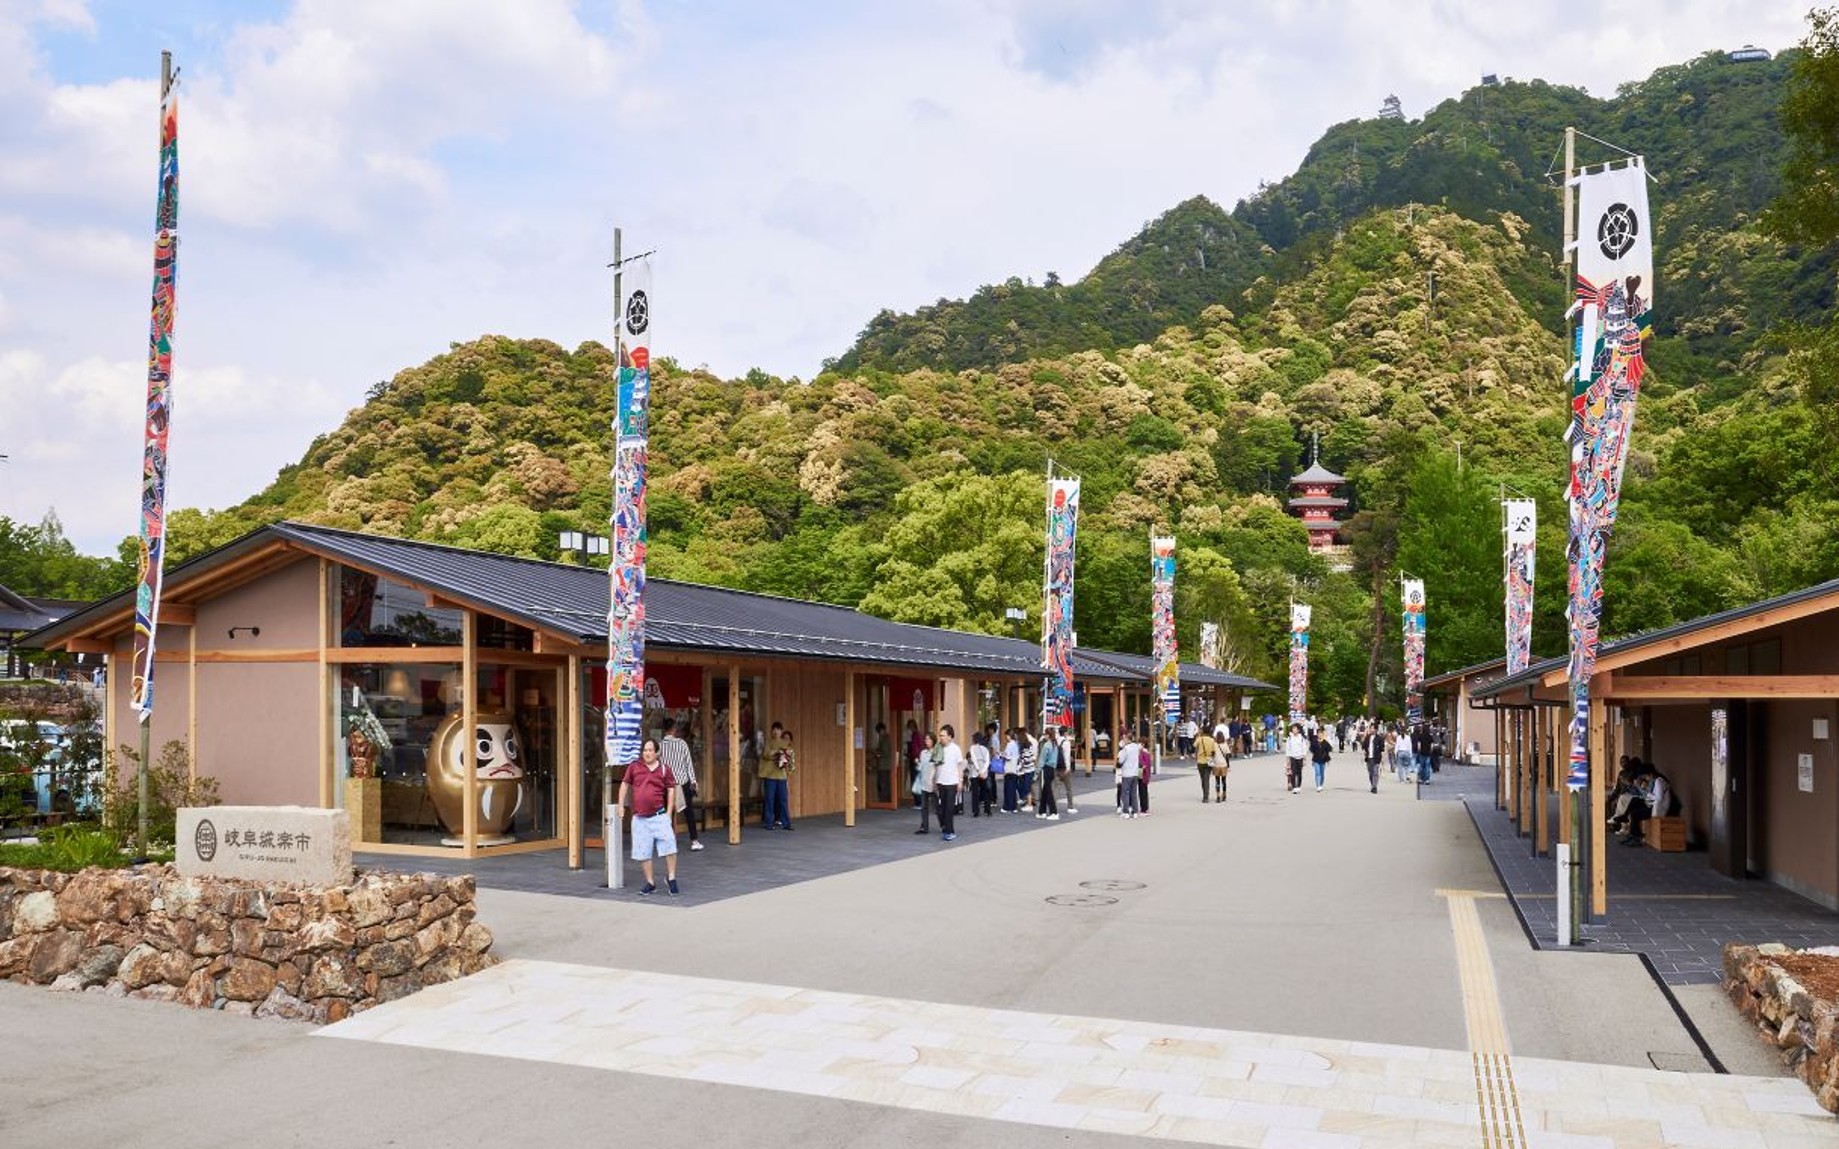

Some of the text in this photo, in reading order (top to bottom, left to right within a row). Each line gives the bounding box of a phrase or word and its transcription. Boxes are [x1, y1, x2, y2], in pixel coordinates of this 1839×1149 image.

[224, 828, 311, 851] 岐阜城楽市
